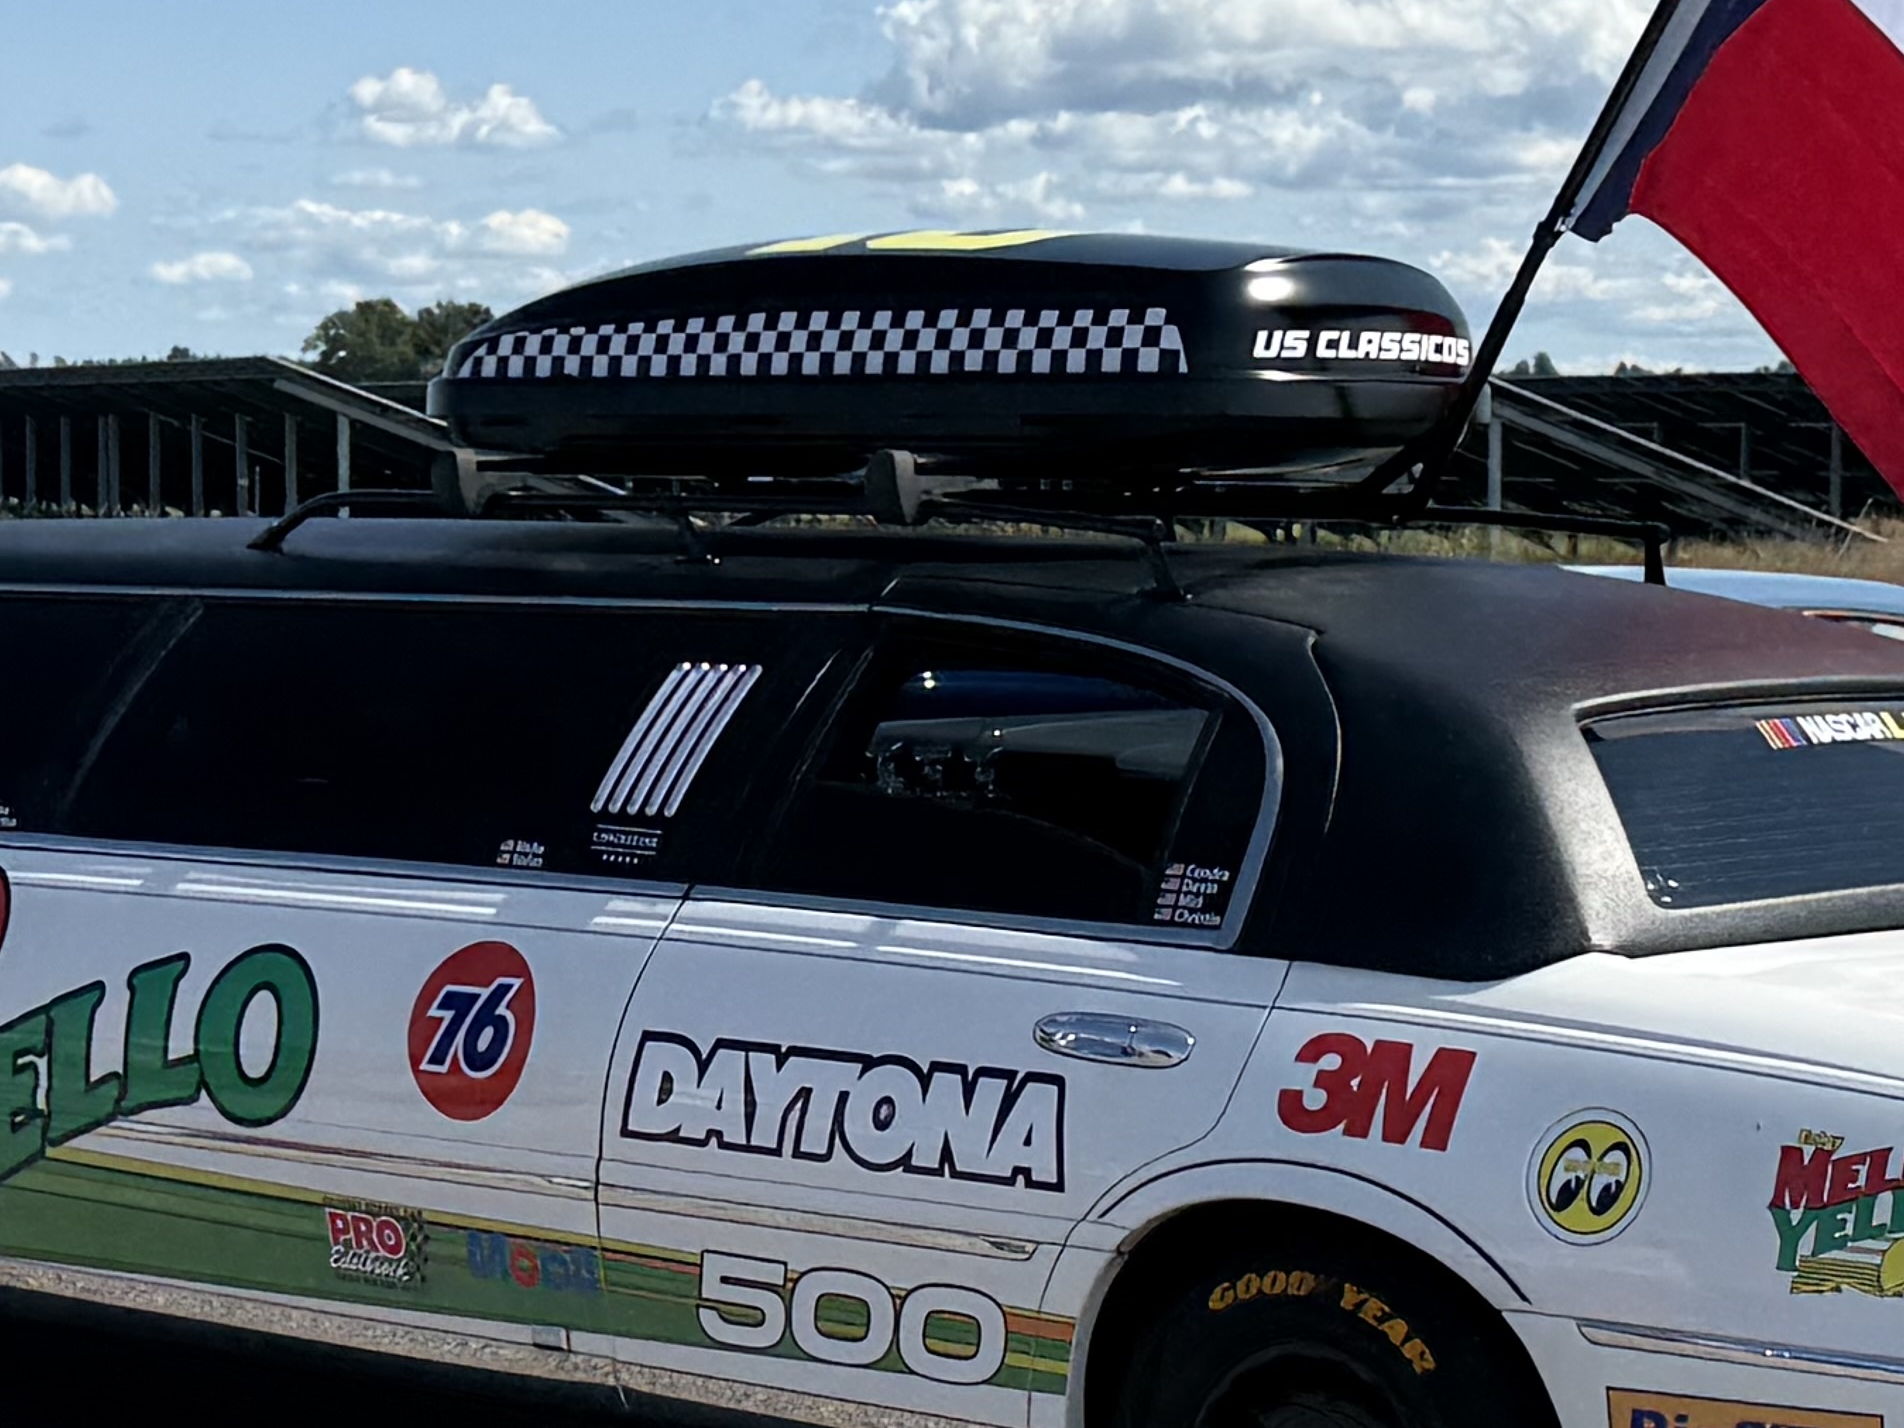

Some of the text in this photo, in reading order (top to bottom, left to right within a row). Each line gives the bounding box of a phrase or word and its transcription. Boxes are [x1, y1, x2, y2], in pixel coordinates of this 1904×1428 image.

[1252, 330, 1470, 366] US CLASSICOS
[420, 976, 524, 1078] 76
[620, 1029, 1066, 1194] DAYTONA
[1277, 1033, 1477, 1152] 3M
[324, 1206, 407, 1260] PRO
[698, 1249, 1008, 1385] 500
[1208, 1270, 1437, 1374] GOOD YEAR
